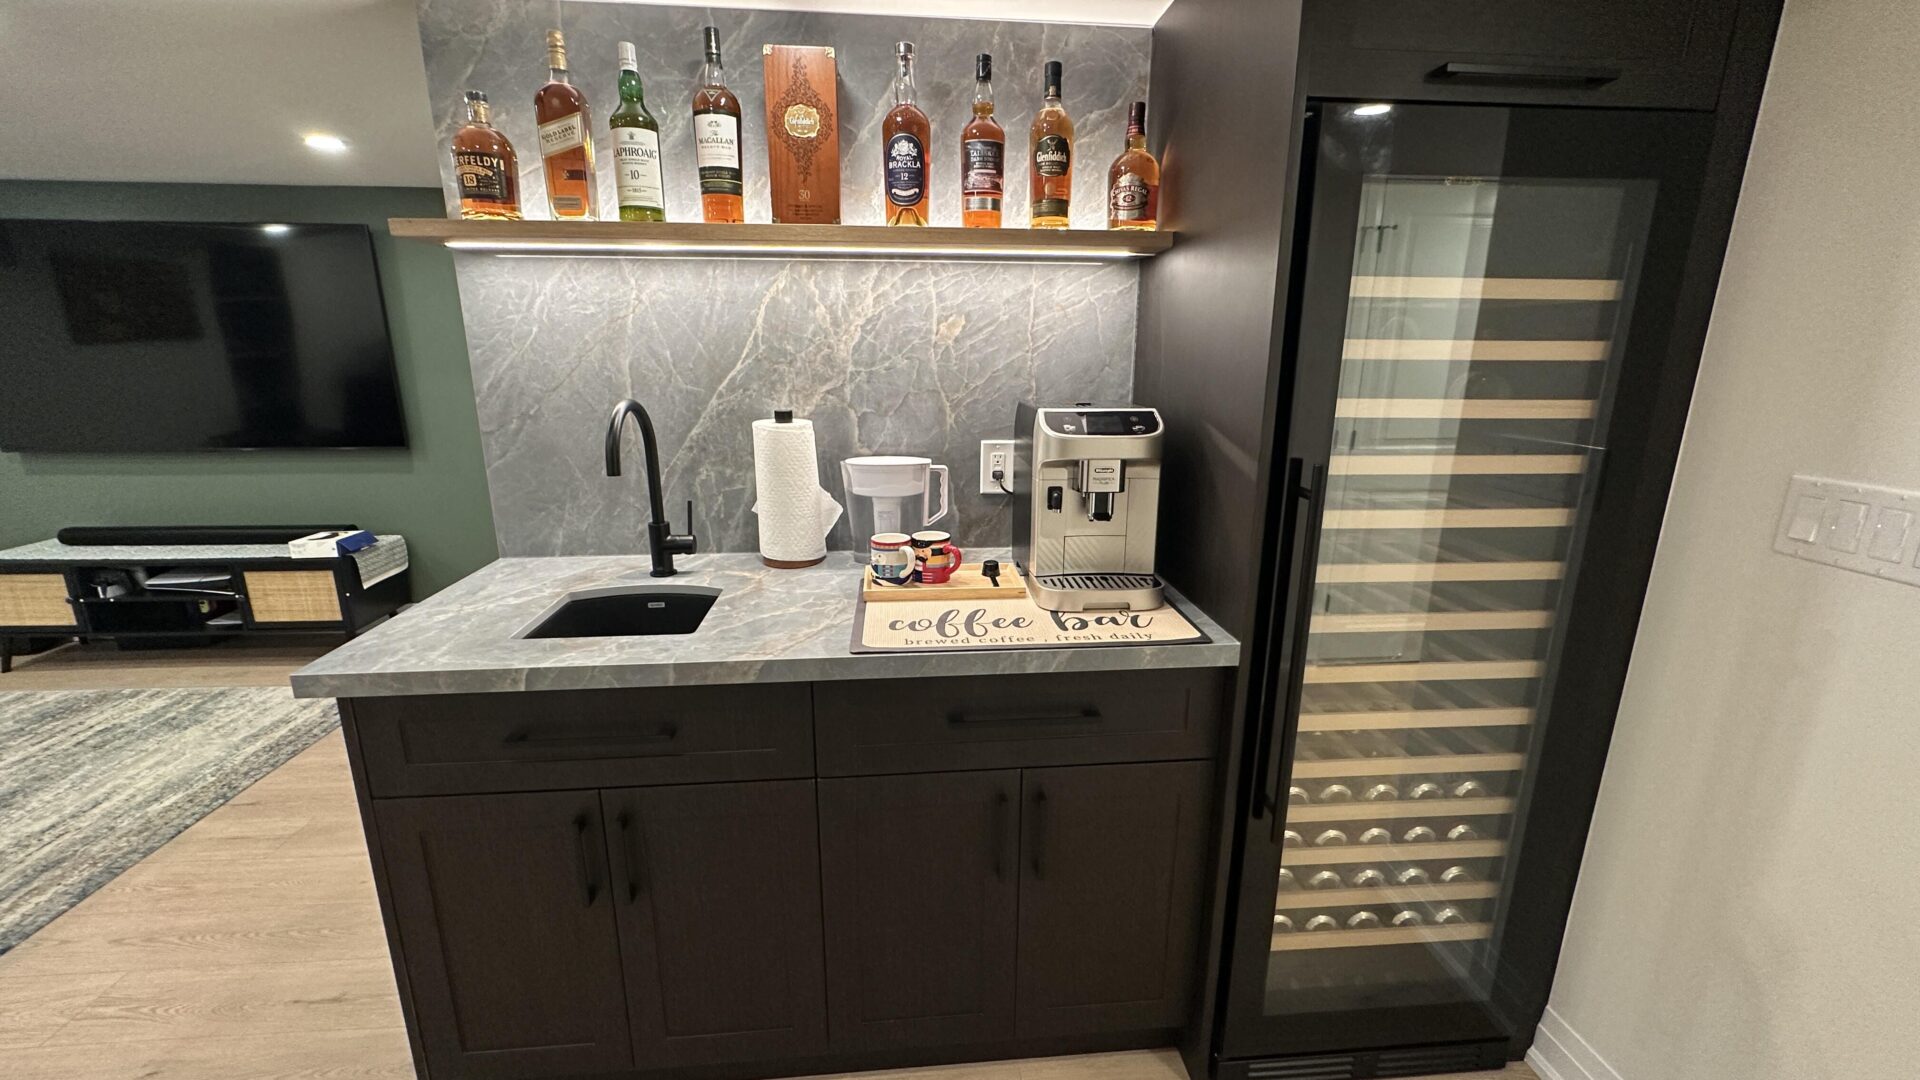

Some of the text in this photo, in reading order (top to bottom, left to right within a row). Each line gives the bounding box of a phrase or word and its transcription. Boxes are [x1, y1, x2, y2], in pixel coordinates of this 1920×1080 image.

[541, 130, 558, 140] GOLD
[557, 124, 577, 135] LABEL
[698, 136, 734, 145] MACALLAN
[614, 146, 657, 159] LAPHROAIG
[1036, 150, 1067, 162] Glenfiddich
[889, 160, 921, 169] BRACKLA
[464, 175, 475, 184] 18
[630, 169, 640, 180] 10
[900, 172, 909, 180] 12
[889, 609, 1153, 638] coffee bar
[905, 637, 970, 645] brewed
[979, 635, 1034, 643] coffee
[1056, 632, 1102, 641] fresh
[1109, 632, 1152, 640] daily
